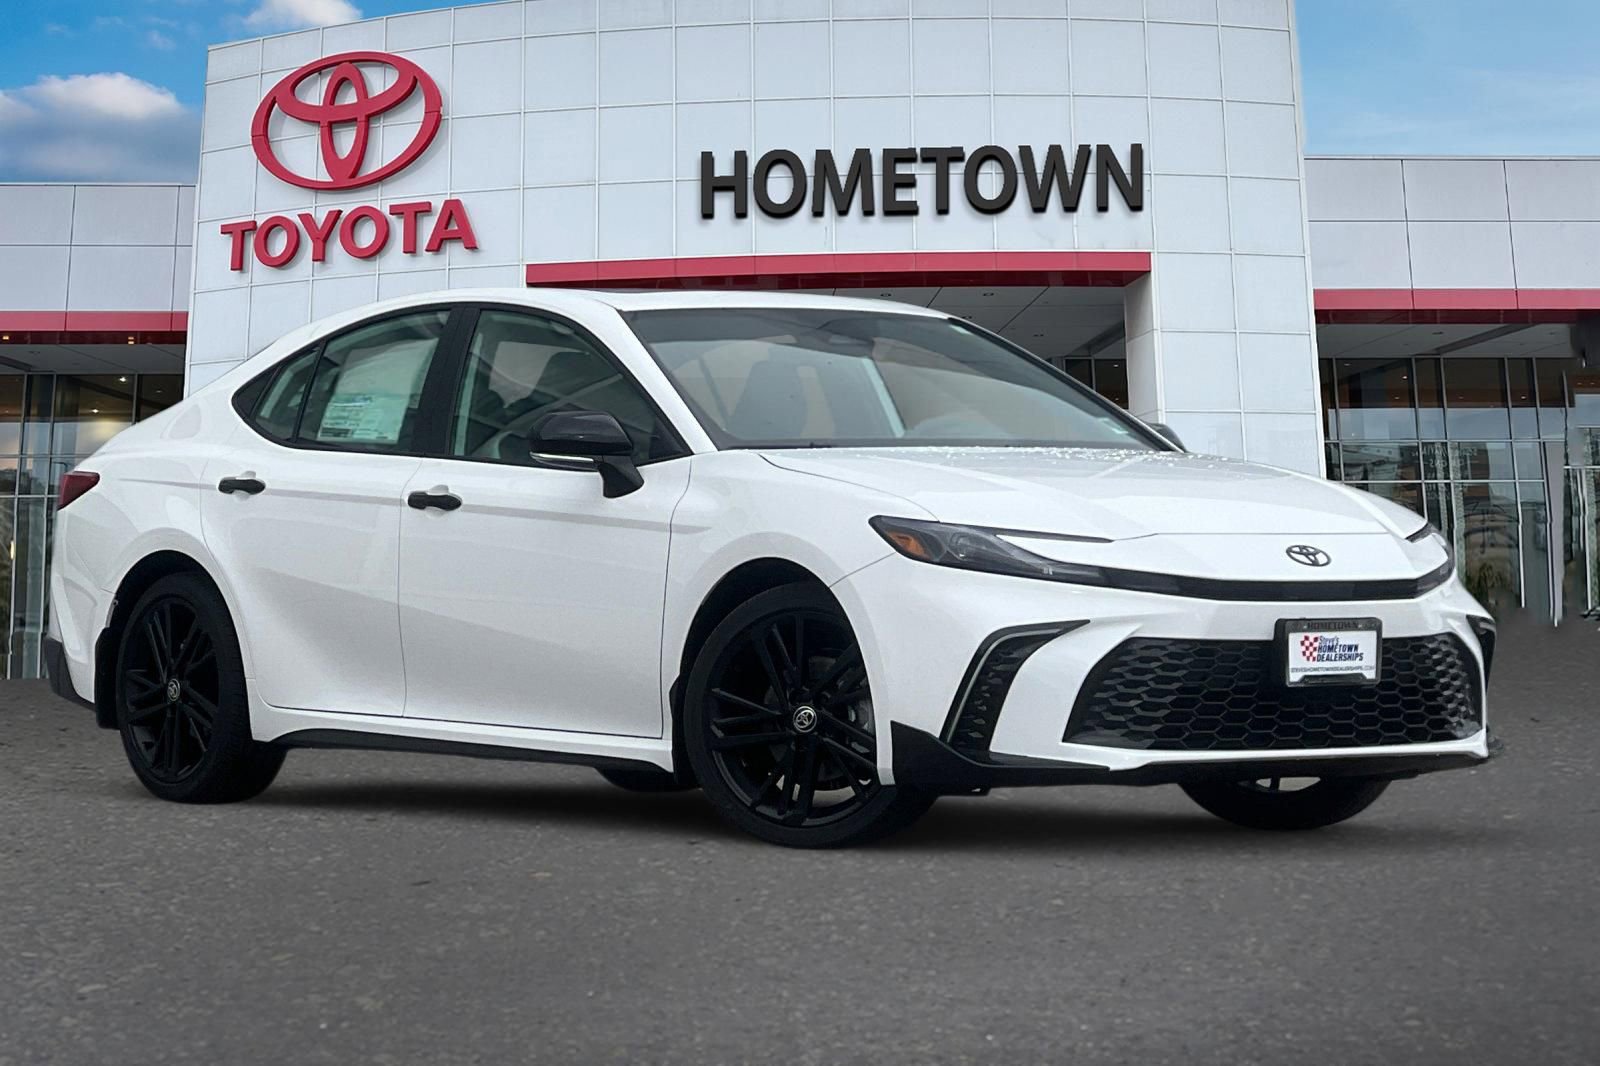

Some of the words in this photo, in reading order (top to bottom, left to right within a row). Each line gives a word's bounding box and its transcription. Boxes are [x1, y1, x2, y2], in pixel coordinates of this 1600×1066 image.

[700, 143, 1144, 220] HOMETOWN
[220, 198, 479, 272] TOYOTA
[1308, 621, 1359, 630] HOMETOWN
[1319, 635, 1340, 645] Steve's
[1317, 644, 1359, 654] HOMETOWN
[1316, 652, 1364, 662] DEALERSHIPS
